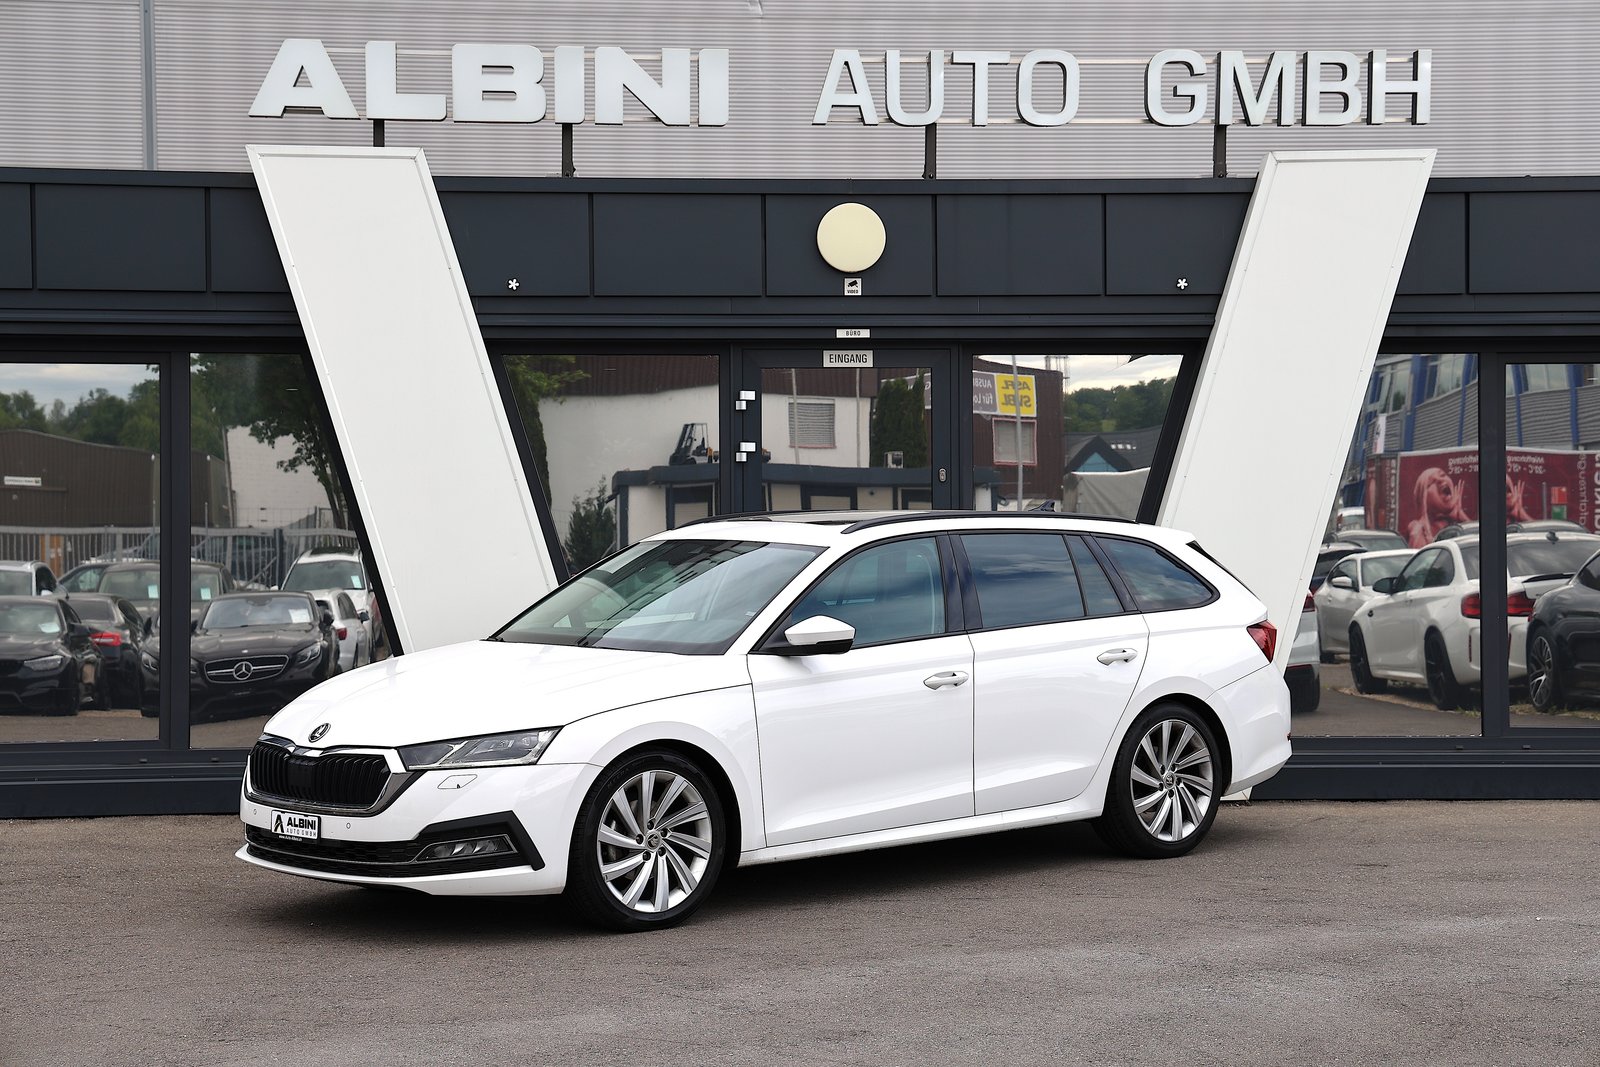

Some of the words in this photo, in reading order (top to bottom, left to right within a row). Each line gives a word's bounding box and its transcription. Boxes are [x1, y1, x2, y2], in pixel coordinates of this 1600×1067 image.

[248, 38, 730, 127] ALBINI
[812, 49, 1080, 127] AUTO
[1145, 49, 1433, 127] GMBH
[845, 329, 861, 337] BÜRO
[829, 353, 868, 364] EINGANG
[287, 816, 316, 831] ALBINI
